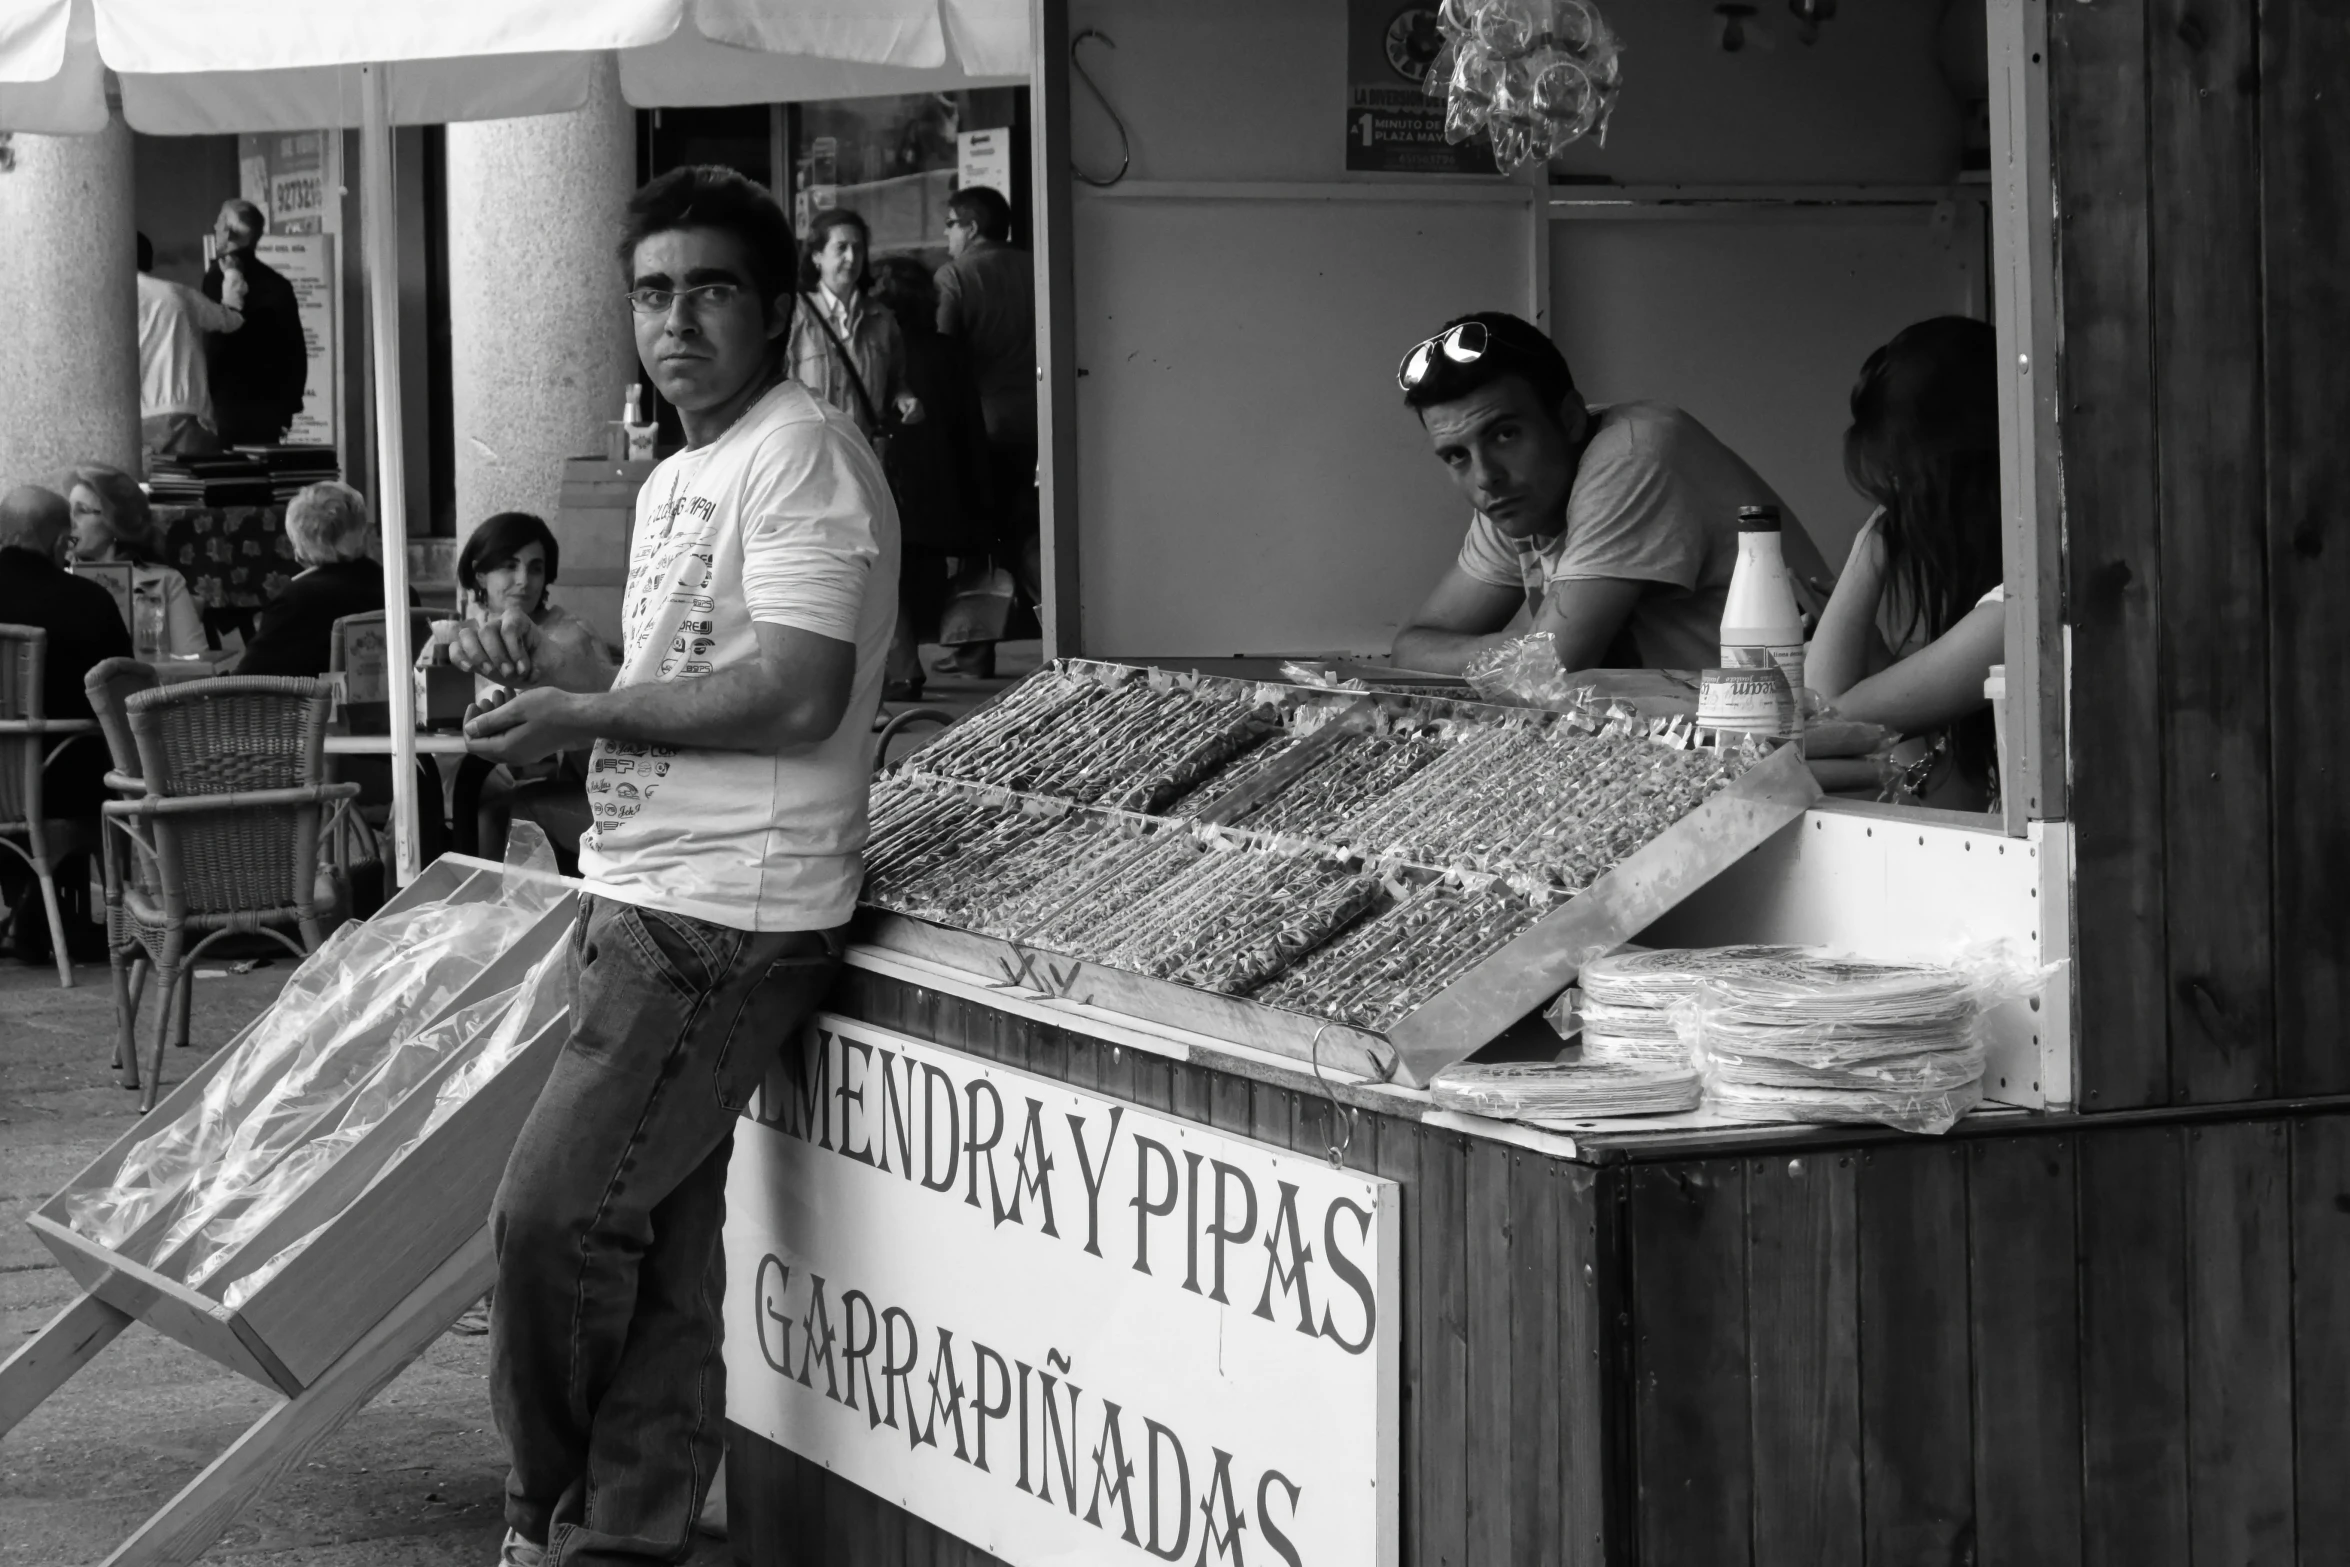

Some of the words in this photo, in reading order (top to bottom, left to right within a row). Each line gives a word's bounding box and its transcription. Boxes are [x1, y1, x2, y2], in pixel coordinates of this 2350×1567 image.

[1350, 124, 1359, 134] A
[1358, 113, 1373, 147] 1
[1374, 119, 1423, 130] MINUTO
[1425, 120, 1441, 130] DE
[1374, 131, 1414, 141] PLAZA
[739, 1023, 1060, 1239] LMENDRA
[1065, 1106, 1124, 1260] Y
[1129, 1133, 1376, 1355] PIPAS
[755, 1252, 1303, 1567] GARRAPIÑADAS
